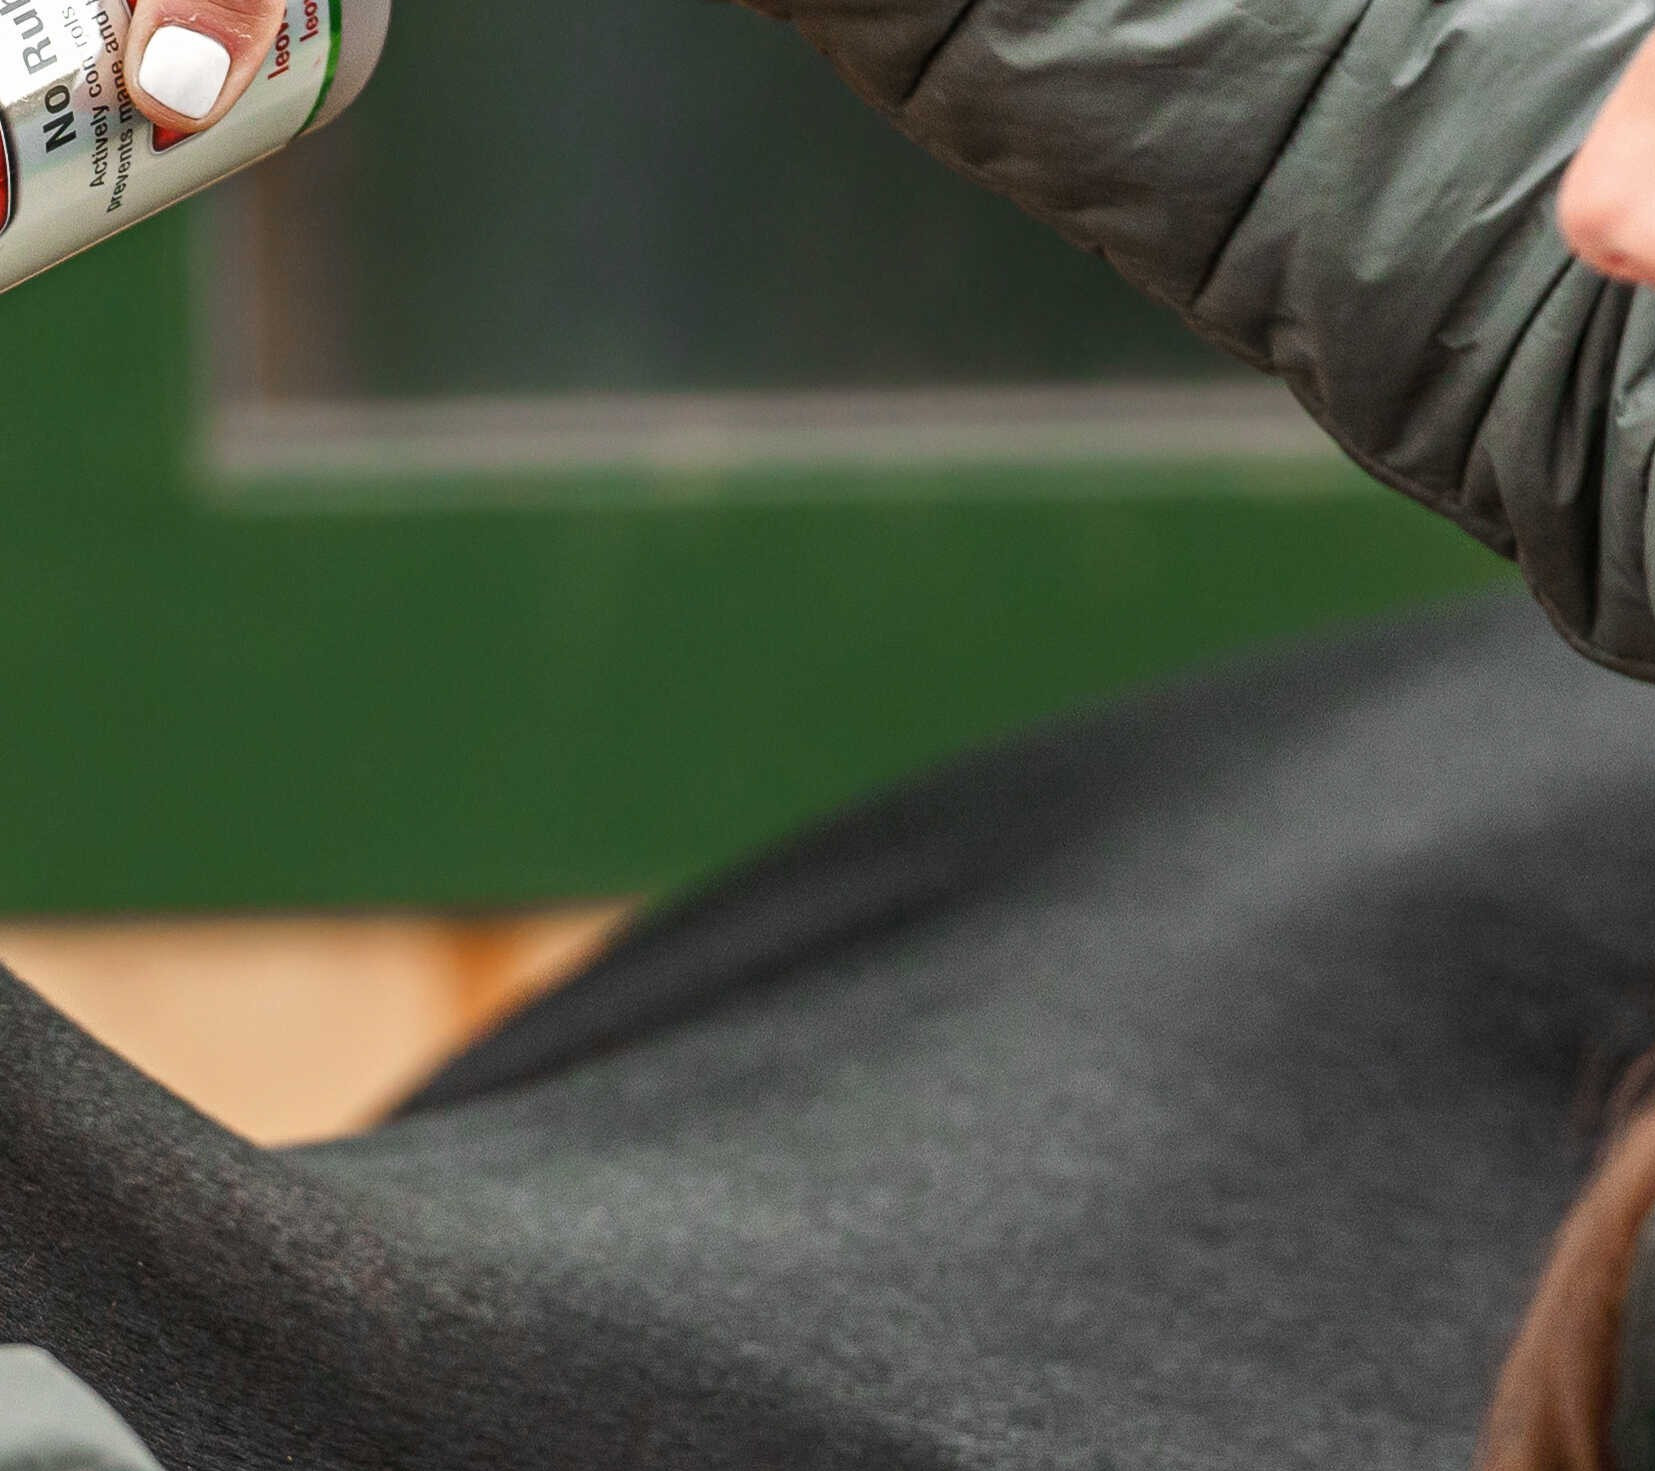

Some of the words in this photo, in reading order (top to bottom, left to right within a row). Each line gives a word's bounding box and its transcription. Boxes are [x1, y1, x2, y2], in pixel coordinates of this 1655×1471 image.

[60, 5, 102, 97] conrols
[91, 10, 119, 52] and
[268, 6, 289, 79] leov
[42, 84, 77, 152] No
[112, 60, 132, 123] mane
[89, 107, 109, 186] Actively
[106, 128, 132, 212] prevents
